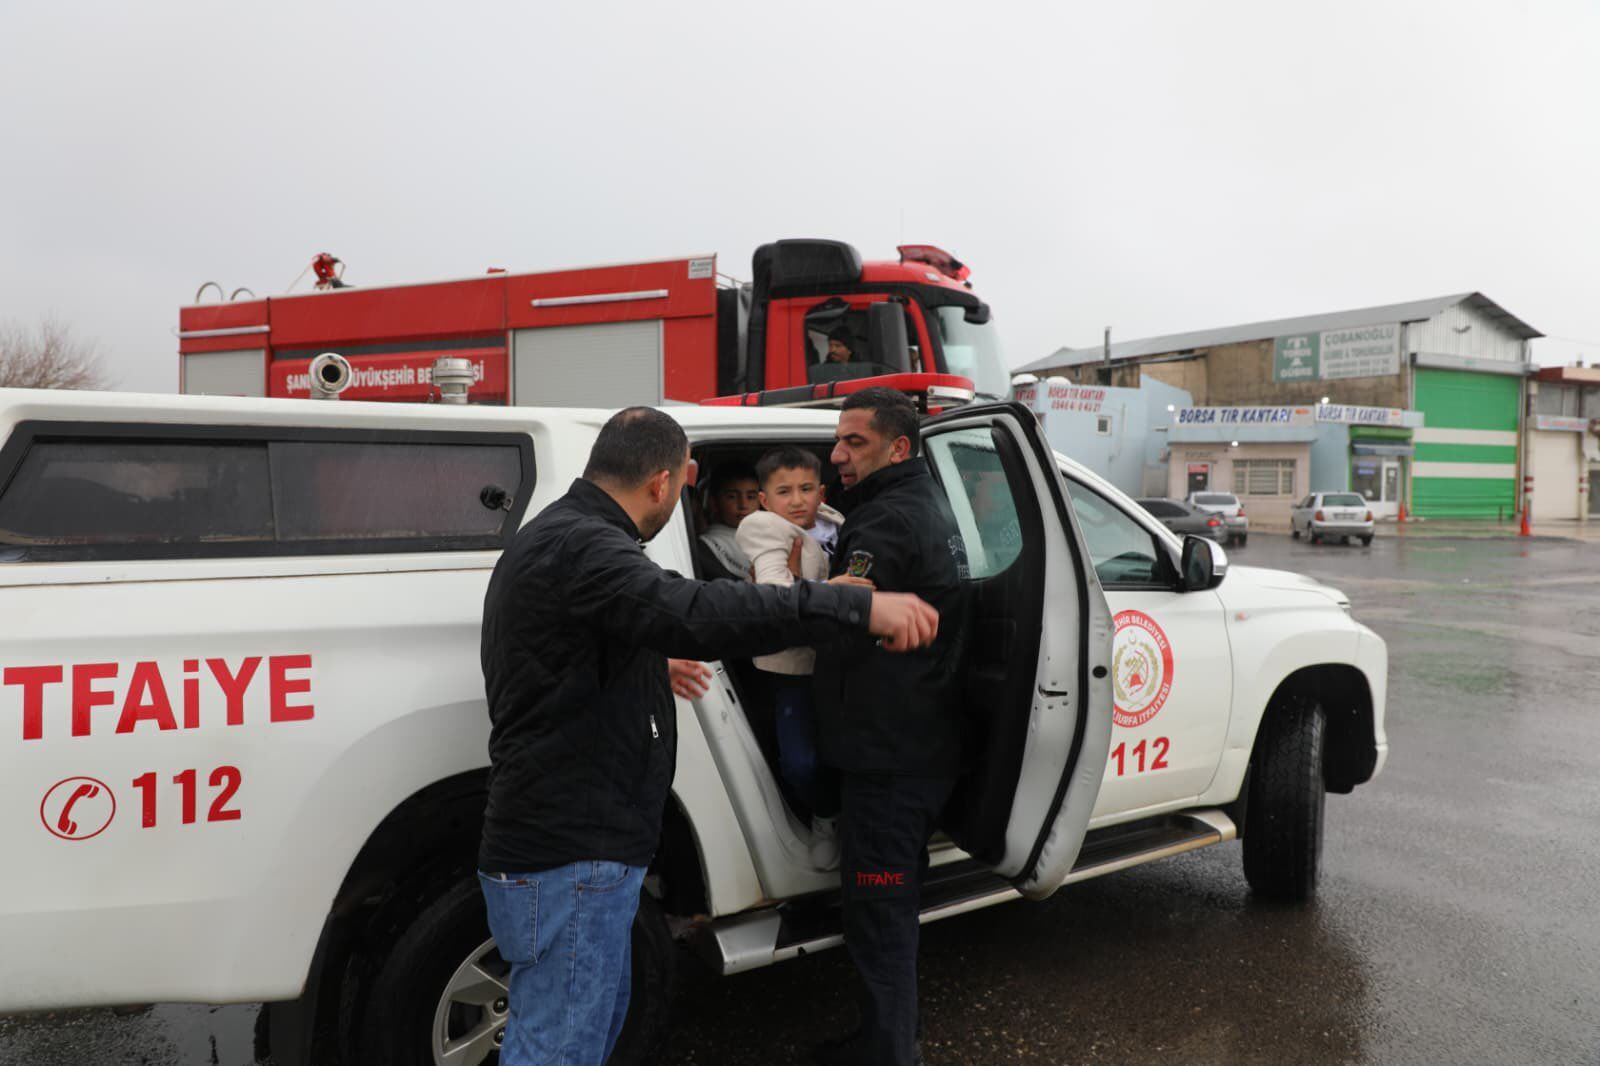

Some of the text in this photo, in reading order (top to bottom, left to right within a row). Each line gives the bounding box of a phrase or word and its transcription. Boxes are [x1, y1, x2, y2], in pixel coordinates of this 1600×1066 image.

[351, 365, 415, 390] ÜYÜKŞEHİR
[1179, 408, 1292, 424] BORSA TIR KANTARI
[1318, 406, 1389, 422] BORSA TIR KANTARI
[4, 654, 314, 740] TFAİYE
[1111, 736, 1170, 777] 112
[132, 765, 242, 829] 112
[856, 871, 905, 887] İTFAİYE
